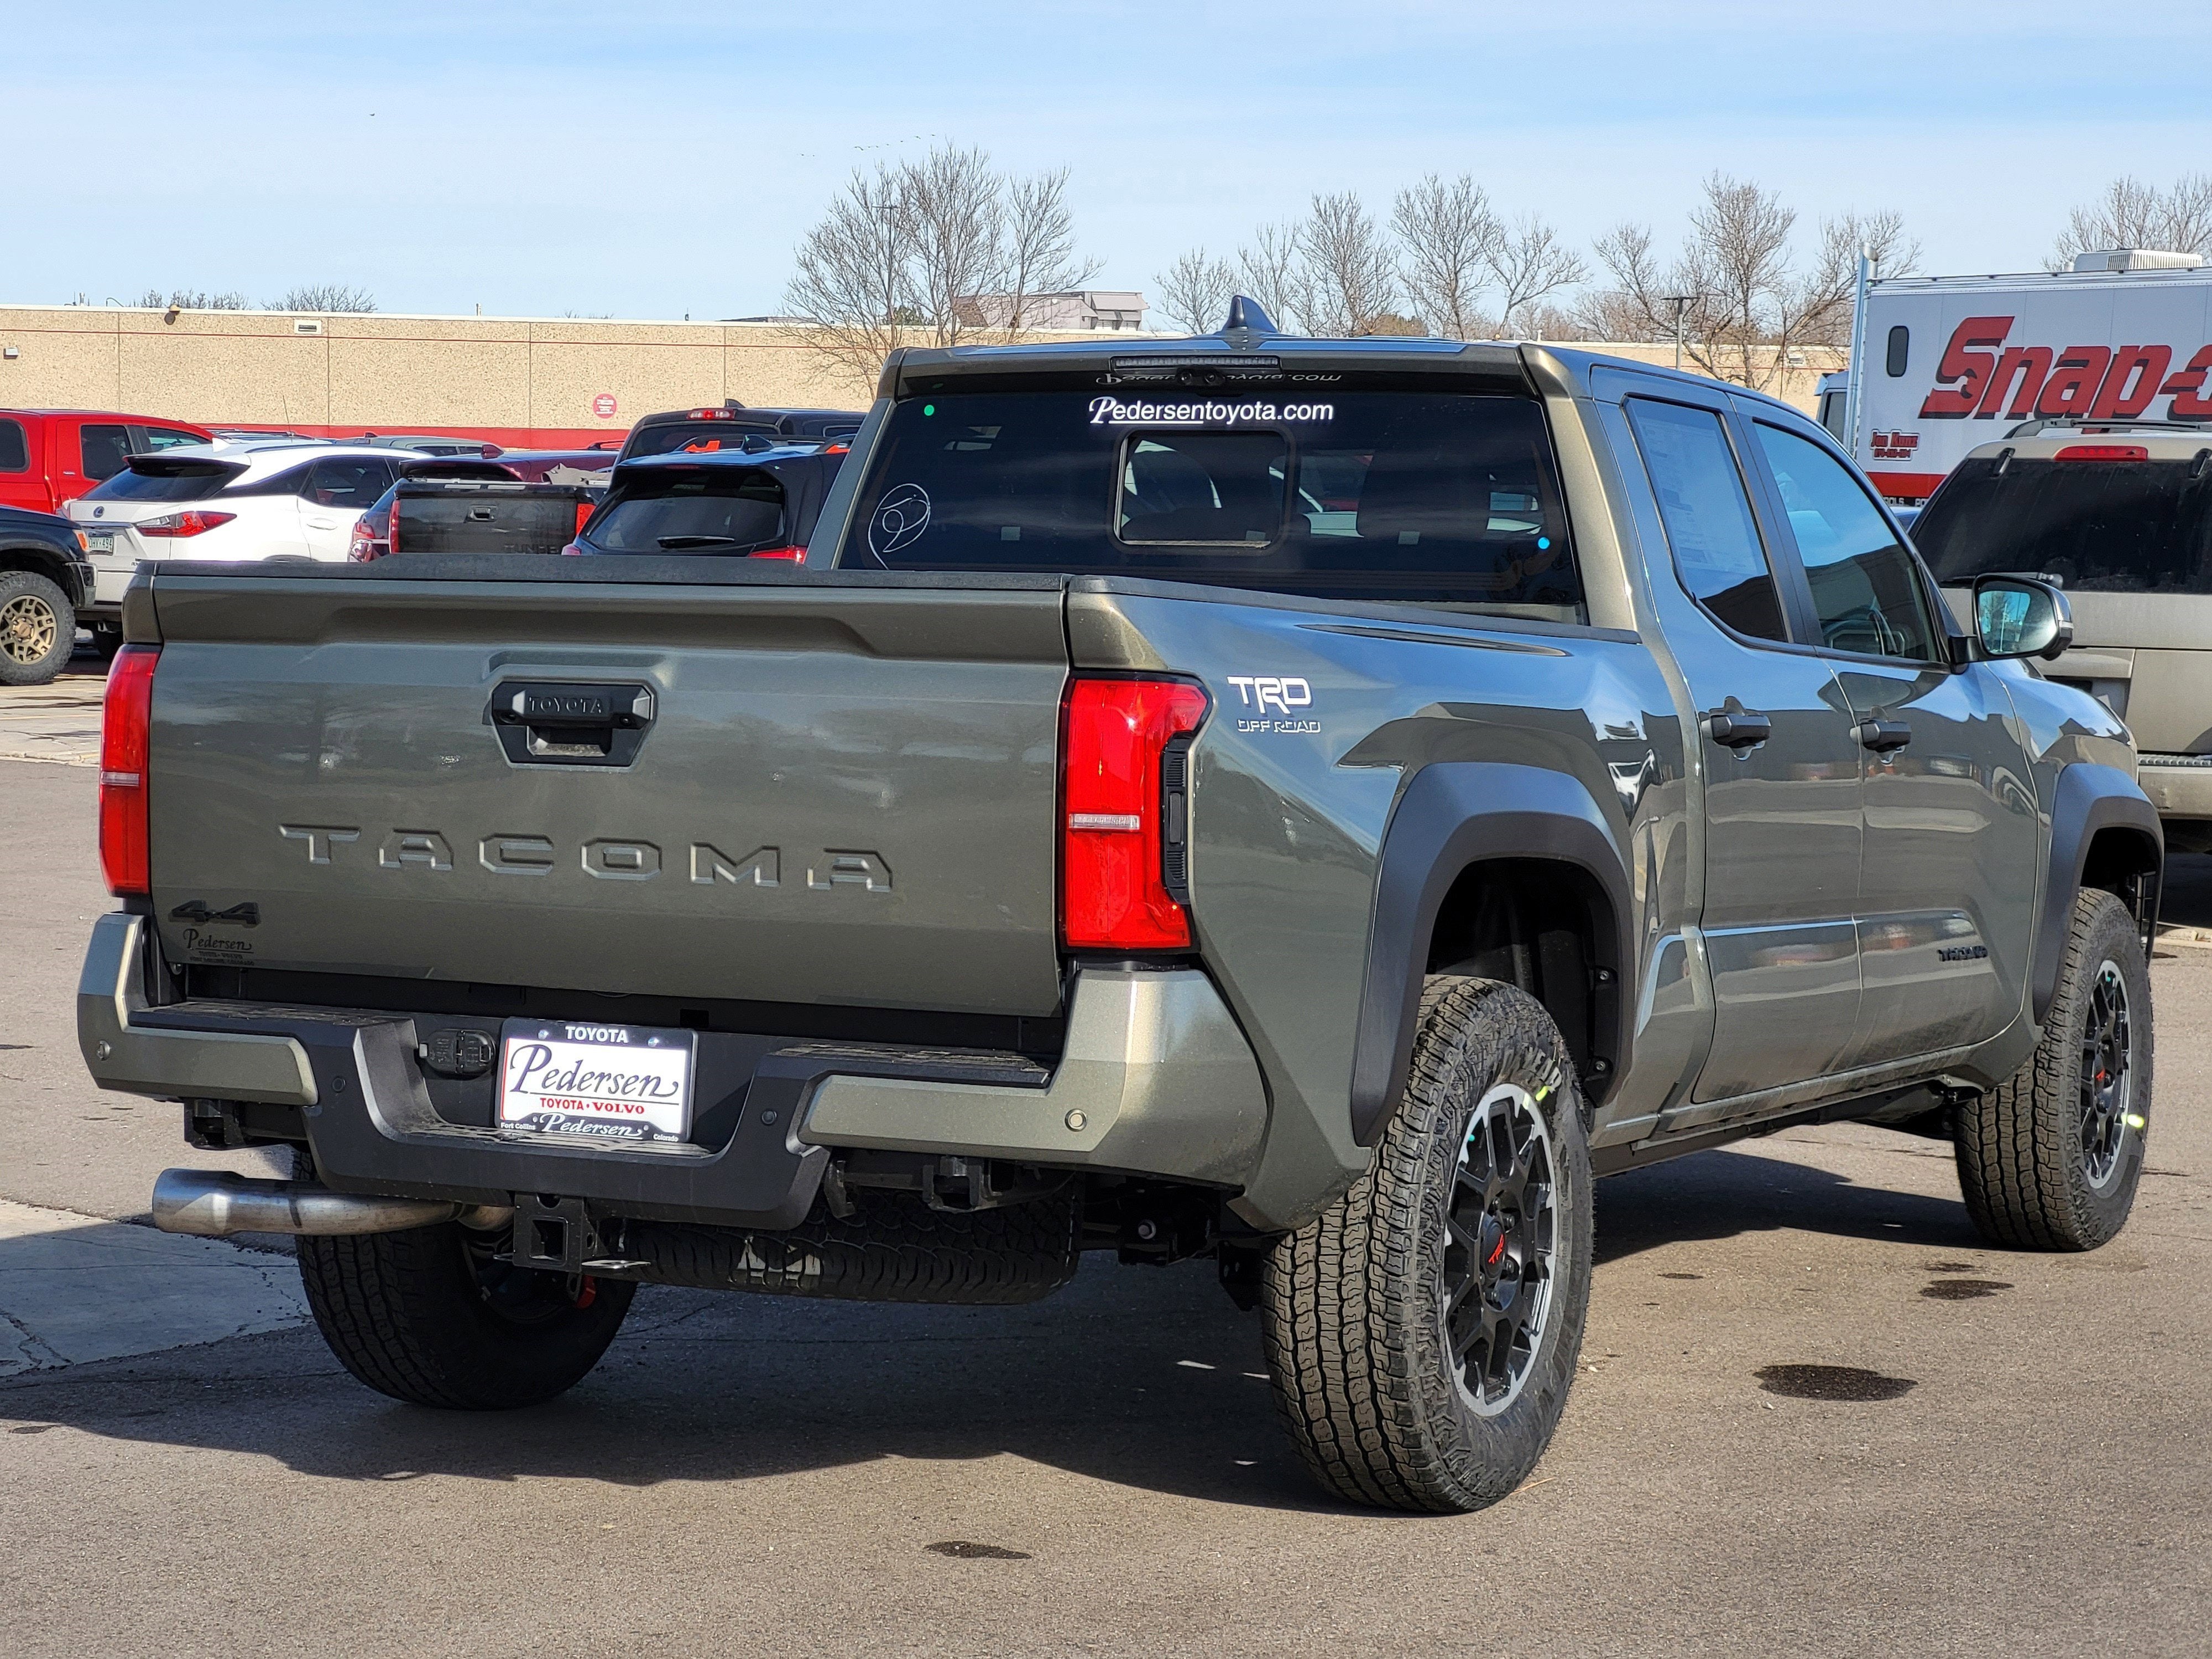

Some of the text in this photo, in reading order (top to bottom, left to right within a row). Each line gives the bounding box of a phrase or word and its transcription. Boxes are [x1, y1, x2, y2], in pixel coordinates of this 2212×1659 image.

[1089, 397, 1333, 425] Pedersentoyota.com
[529, 696, 602, 713] TOYOTA
[1227, 676, 1312, 714] TRD
[1238, 719, 1321, 733] OFF ROAD
[278, 823, 894, 893] TACOMA
[183, 928, 252, 950] Pedersen
[565, 1026, 629, 1044] TOYOTA
[510, 1044, 680, 1098] Pedersen
[540, 1098, 645, 1115] TOYOTA VOLVO
[539, 1113, 643, 1136] Pedersen
[653, 1134, 679, 1142] Colorado
